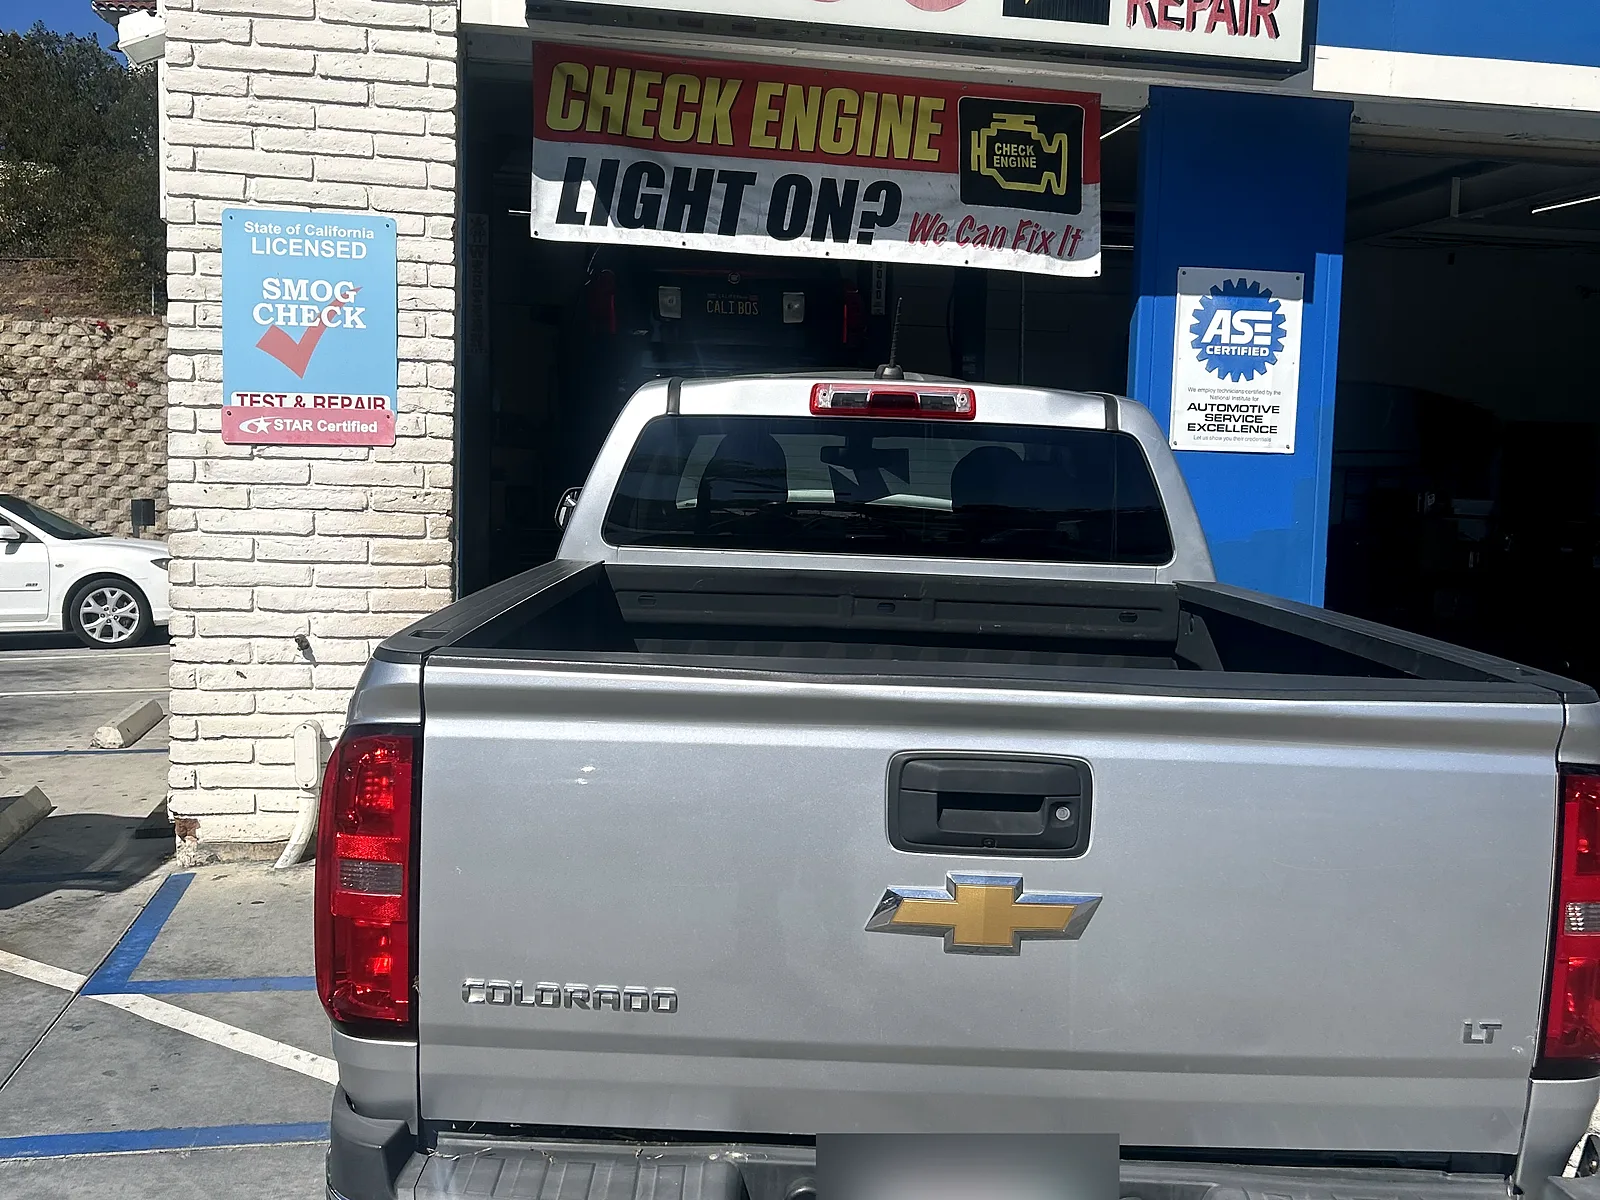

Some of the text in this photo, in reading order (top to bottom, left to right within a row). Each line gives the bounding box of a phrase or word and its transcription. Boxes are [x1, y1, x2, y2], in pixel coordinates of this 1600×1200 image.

[546, 62, 946, 162] CHECK ENGINE
[994, 142, 1035, 156] CHECK
[993, 156, 1037, 168] ENGINE
[555, 156, 903, 245] LIGHT ON?
[244, 221, 375, 239] State of California
[908, 211, 1082, 257] We Can Fix It
[251, 236, 367, 260] LICENSED
[262, 277, 357, 303] SMOG
[252, 302, 367, 329] CHECK
[1201, 309, 1273, 346] ASE
[1205, 345, 1270, 357] CERTIFIED
[236, 393, 386, 410] TEST & REPAIR
[1187, 402, 1280, 414] AUTOMOTIVE
[273, 419, 377, 433] STAR Certified
[1187, 422, 1278, 434] EXCELLENCE
[1204, 413, 1263, 424] SERVICE
[461, 977, 678, 1014] COLORADO
[1462, 1020, 1502, 1044] LT
